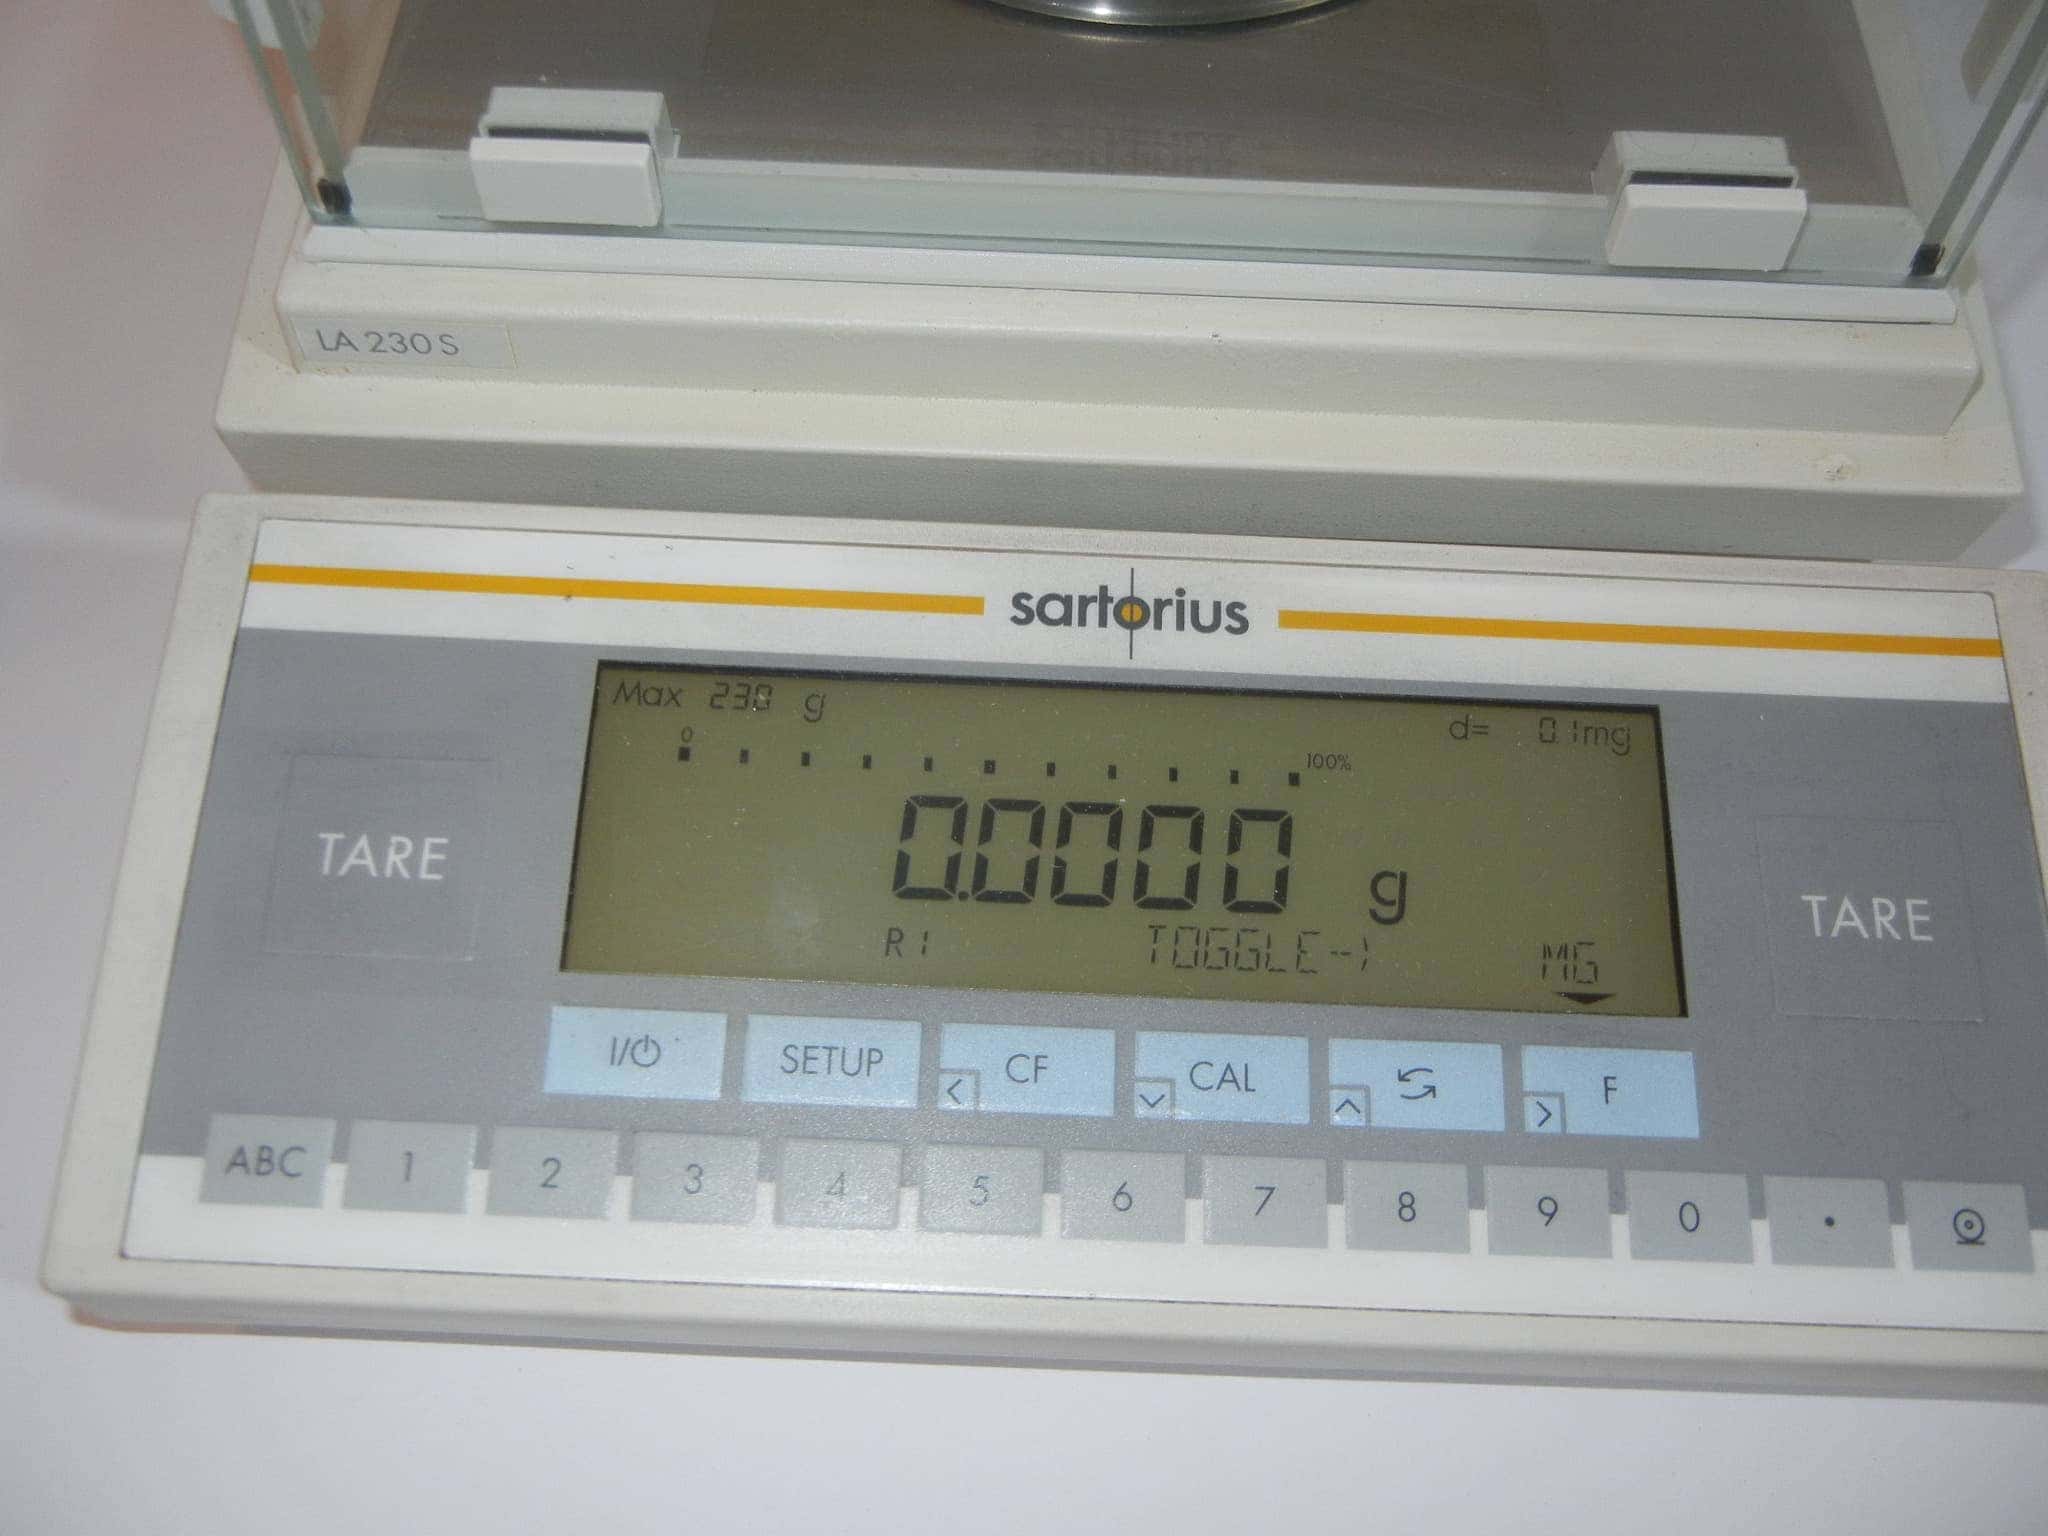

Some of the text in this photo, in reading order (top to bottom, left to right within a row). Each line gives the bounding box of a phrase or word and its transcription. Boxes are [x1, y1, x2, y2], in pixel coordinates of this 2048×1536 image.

[315, 329, 460, 356] LA 230 S
[1010, 584, 1250, 635] sartorius
[613, 680, 825, 723] Max 230 g
[1306, 751, 1352, 772] 100%
[318, 832, 449, 881] TARE
[1368, 869, 1408, 926] g
[1801, 895, 1933, 942] TARE
[779, 1043, 884, 1079] SETUP
[1005, 1053, 1049, 1085] CF
[1189, 1060, 1257, 1094] CAL
[1604, 1075, 1618, 1104] F
[226, 1145, 308, 1179] ABC
[402, 1152, 414, 1183] 1
[540, 1158, 562, 1189] 2
[683, 1164, 704, 1195] 3
[825, 1172, 847, 1200] 4
[970, 1175, 990, 1207] 5
[1112, 1181, 1134, 1213] 6
[1255, 1186, 1276, 1217] 7
[1397, 1190, 1418, 1223] 8
[1537, 1196, 1559, 1227] 9
[1679, 1201, 1701, 1233] 0
